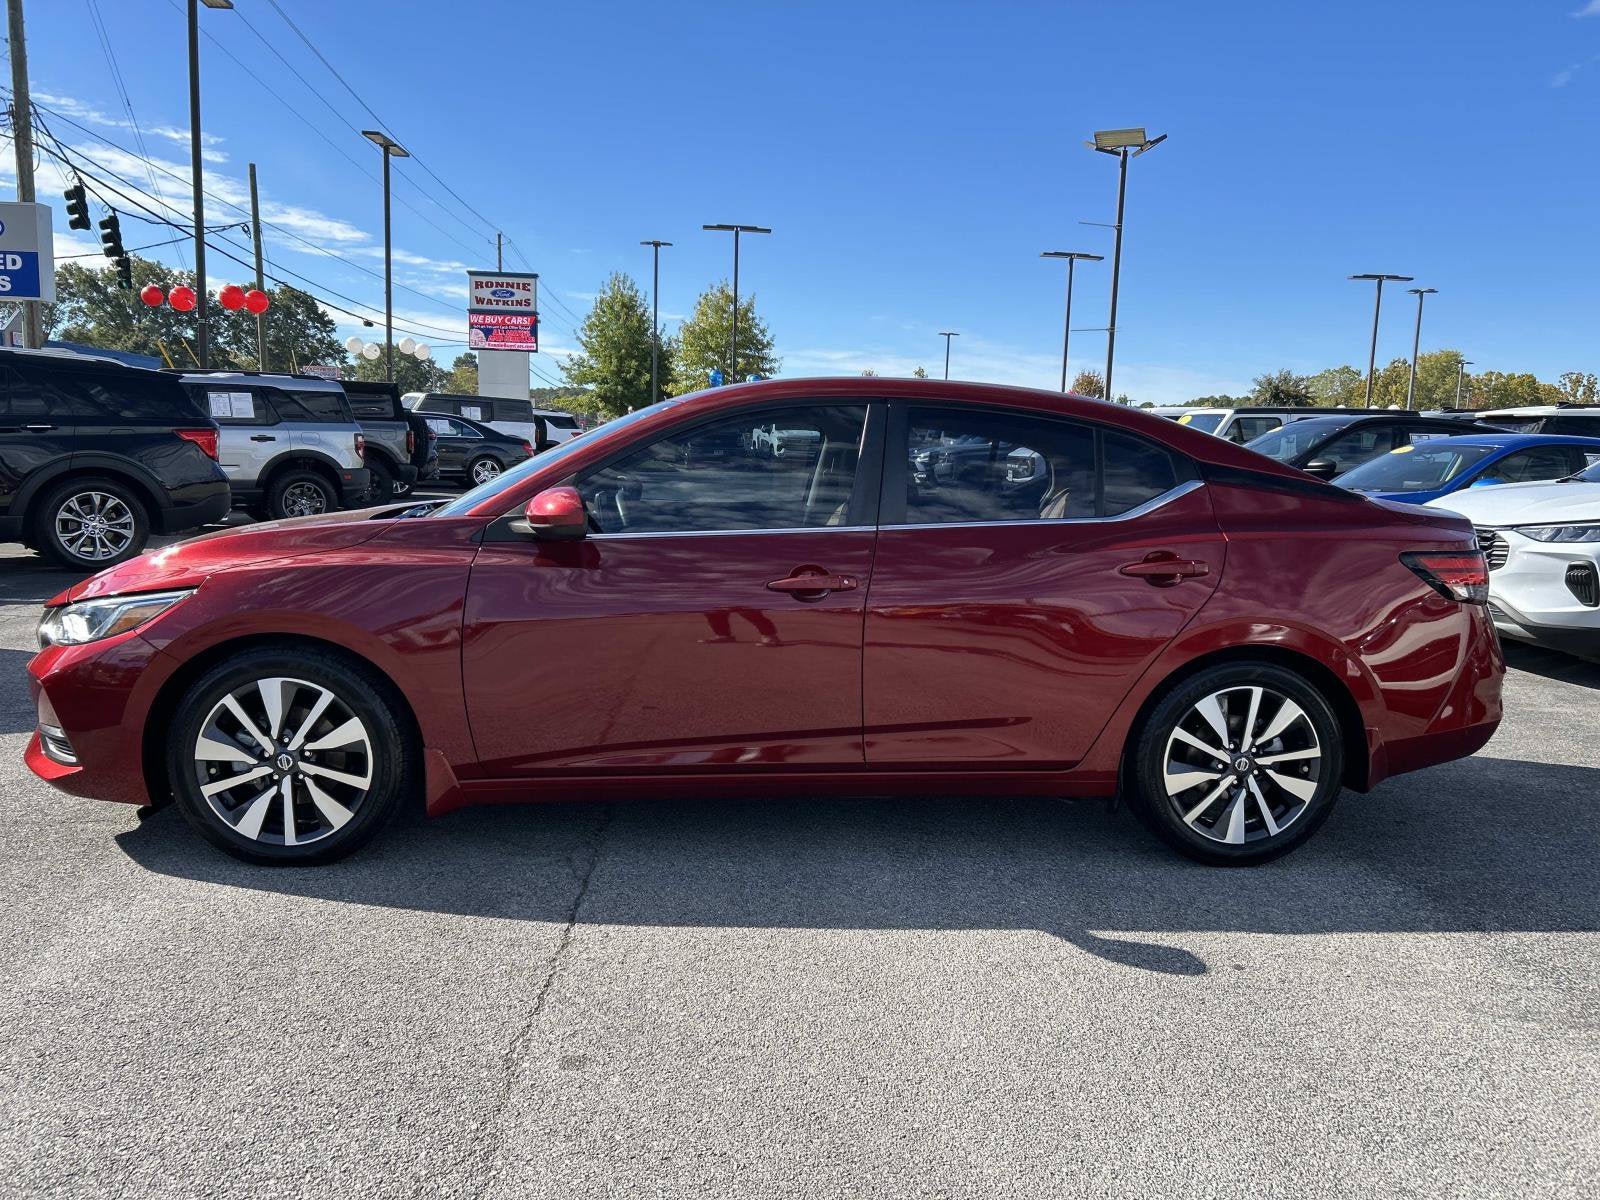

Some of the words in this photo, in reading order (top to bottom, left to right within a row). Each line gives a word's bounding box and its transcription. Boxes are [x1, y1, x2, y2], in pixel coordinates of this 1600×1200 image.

[474, 280, 531, 292] RONNIE
[474, 296, 531, 307] WATKINS
[470, 314, 484, 323] WE
[485, 315, 503, 323] BUY
[504, 316, 531, 325] CARS!
